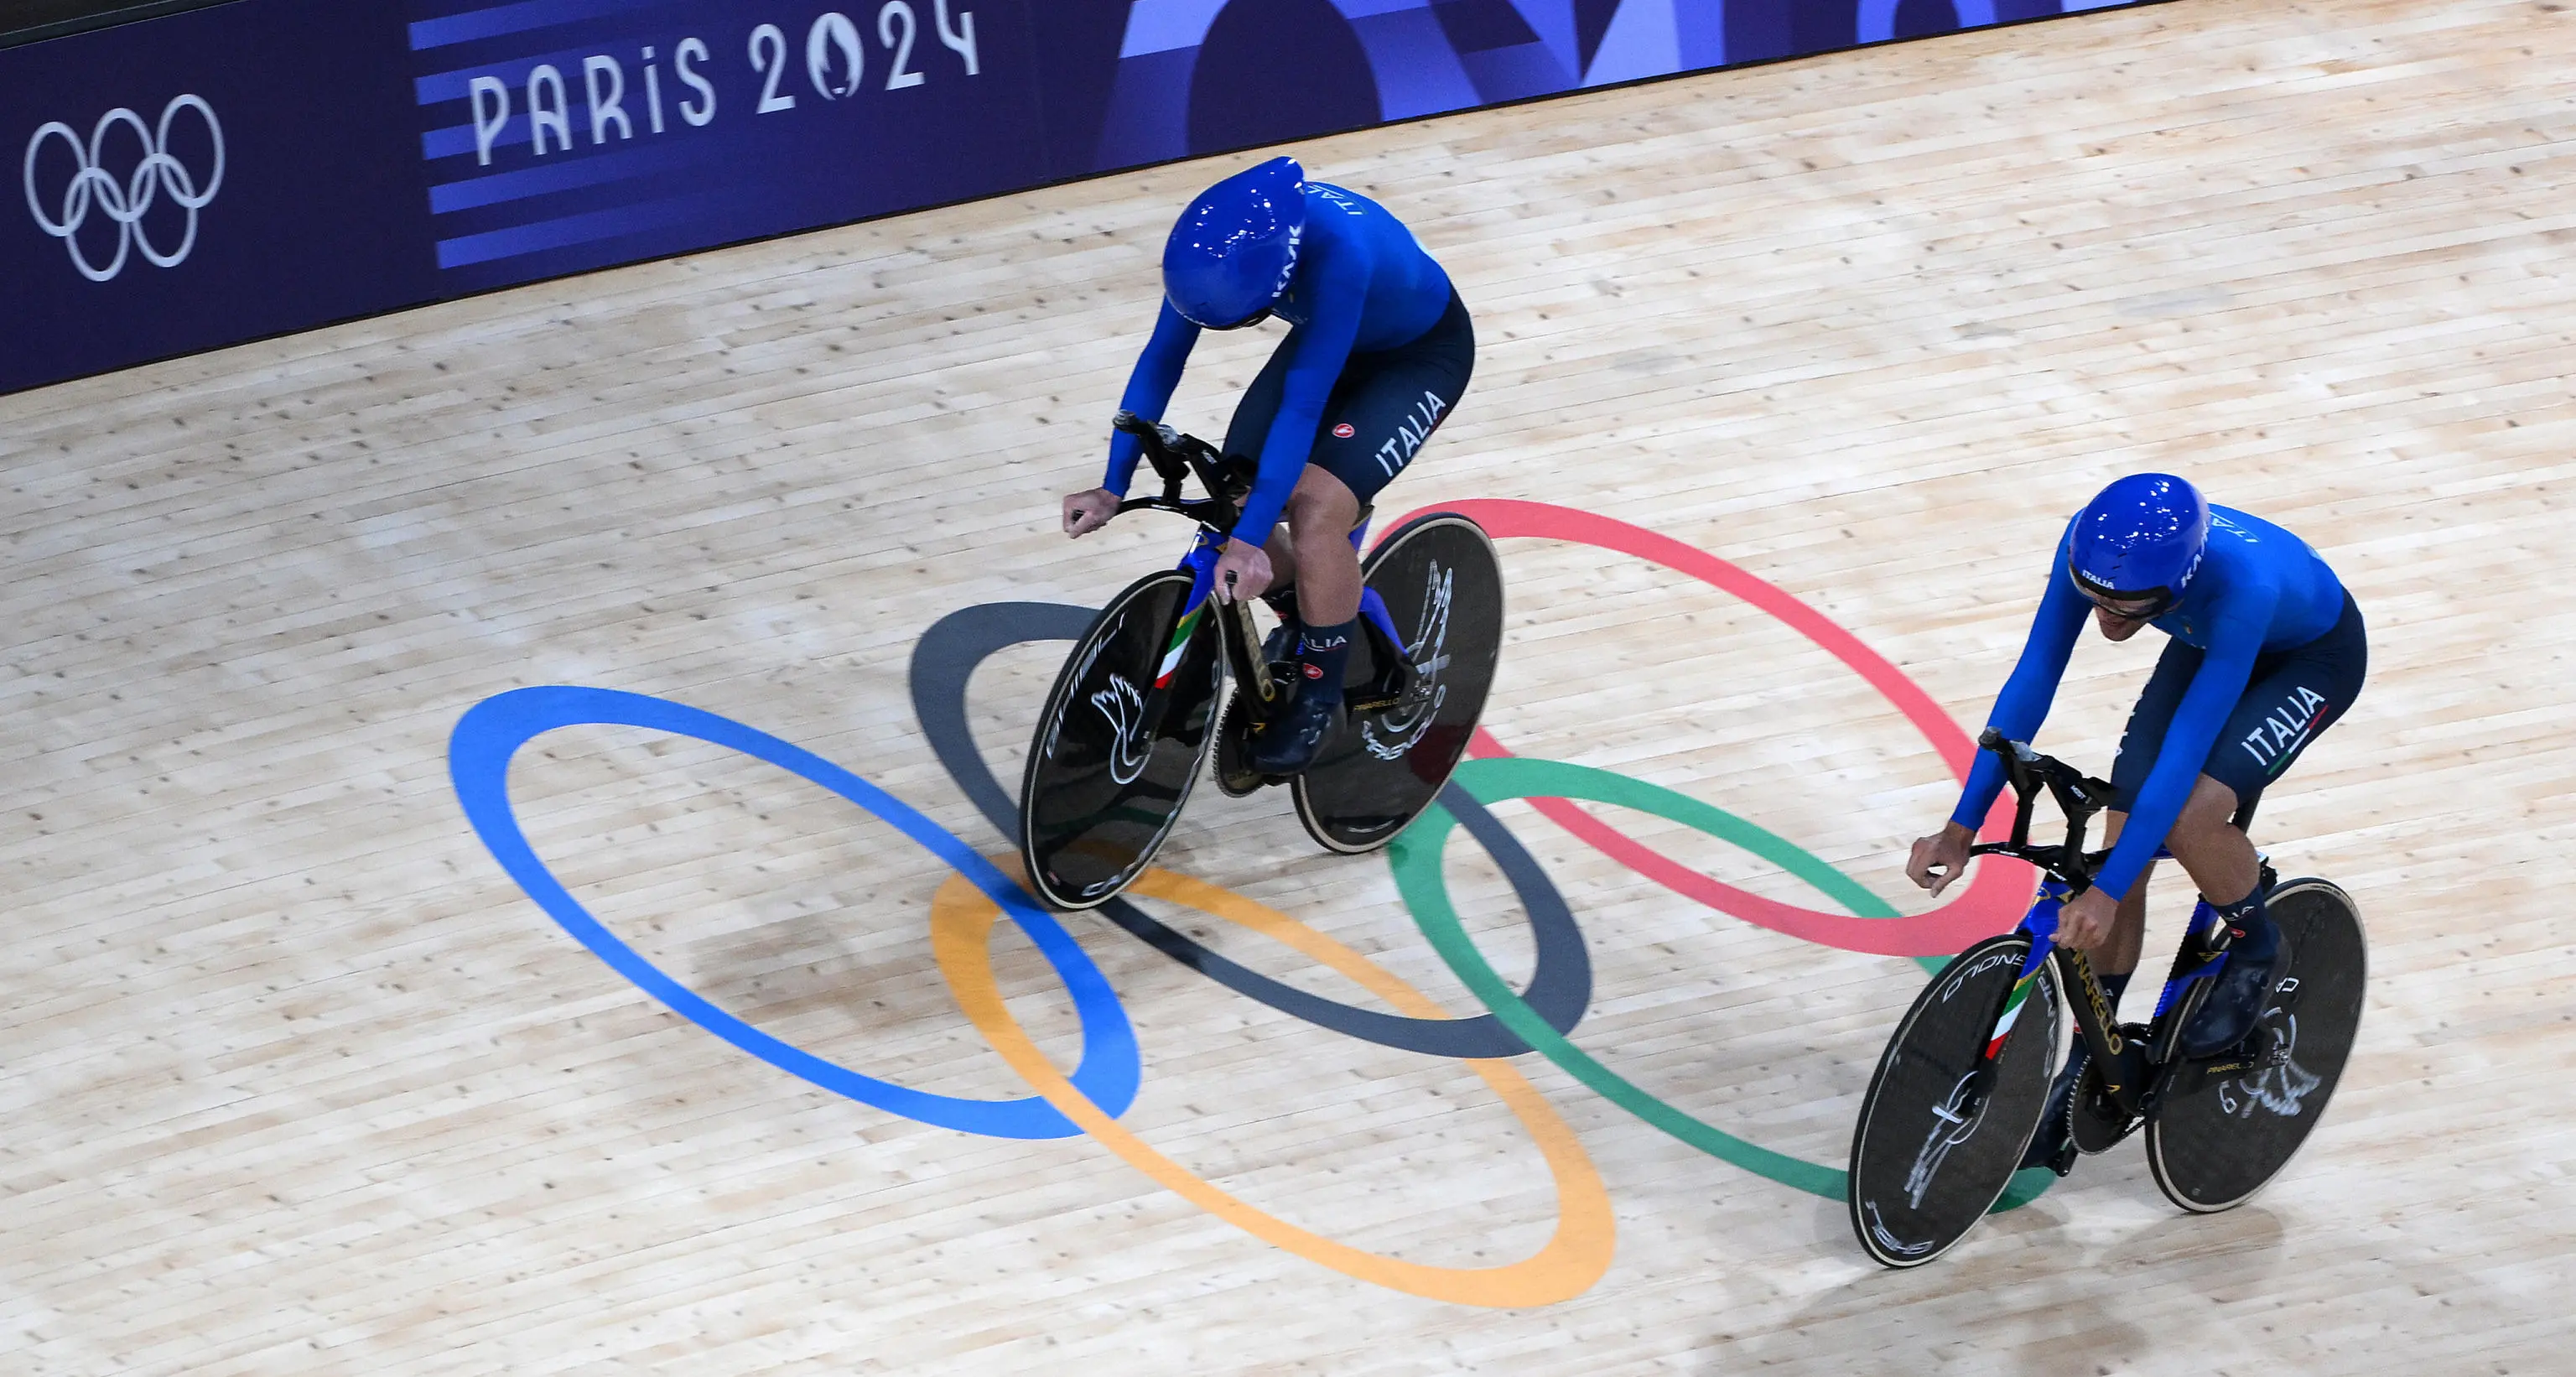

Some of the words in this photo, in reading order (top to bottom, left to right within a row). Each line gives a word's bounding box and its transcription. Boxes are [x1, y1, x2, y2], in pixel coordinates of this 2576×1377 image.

[747, 0, 980, 115] 2024
[1308, 185, 1363, 216] ITAL
[1375, 391, 1446, 477] ITALIA
[2082, 569, 2115, 590] ITALIA
[2241, 686, 2326, 766] ITALIA
[2073, 948, 2124, 1056] INARELLO
